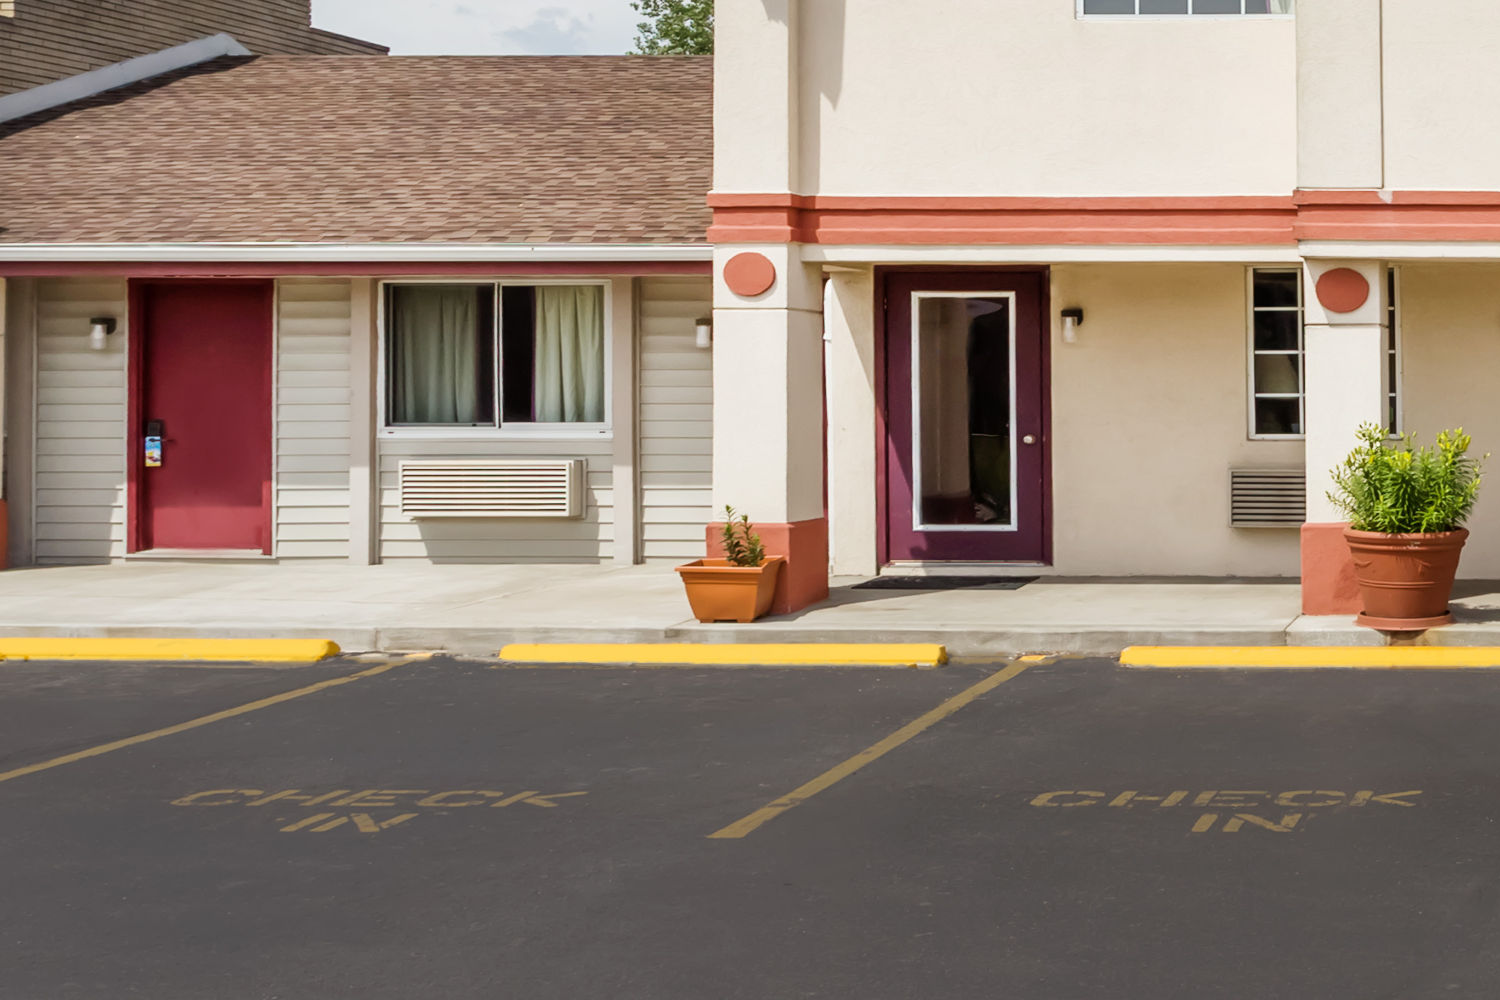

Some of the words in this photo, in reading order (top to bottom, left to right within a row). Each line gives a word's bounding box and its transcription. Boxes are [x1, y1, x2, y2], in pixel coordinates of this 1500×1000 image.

[170, 788, 590, 808] CHECK
[1028, 789, 1424, 808] CHECK
[279, 812, 419, 833] IN
[1191, 812, 1304, 833] IN
